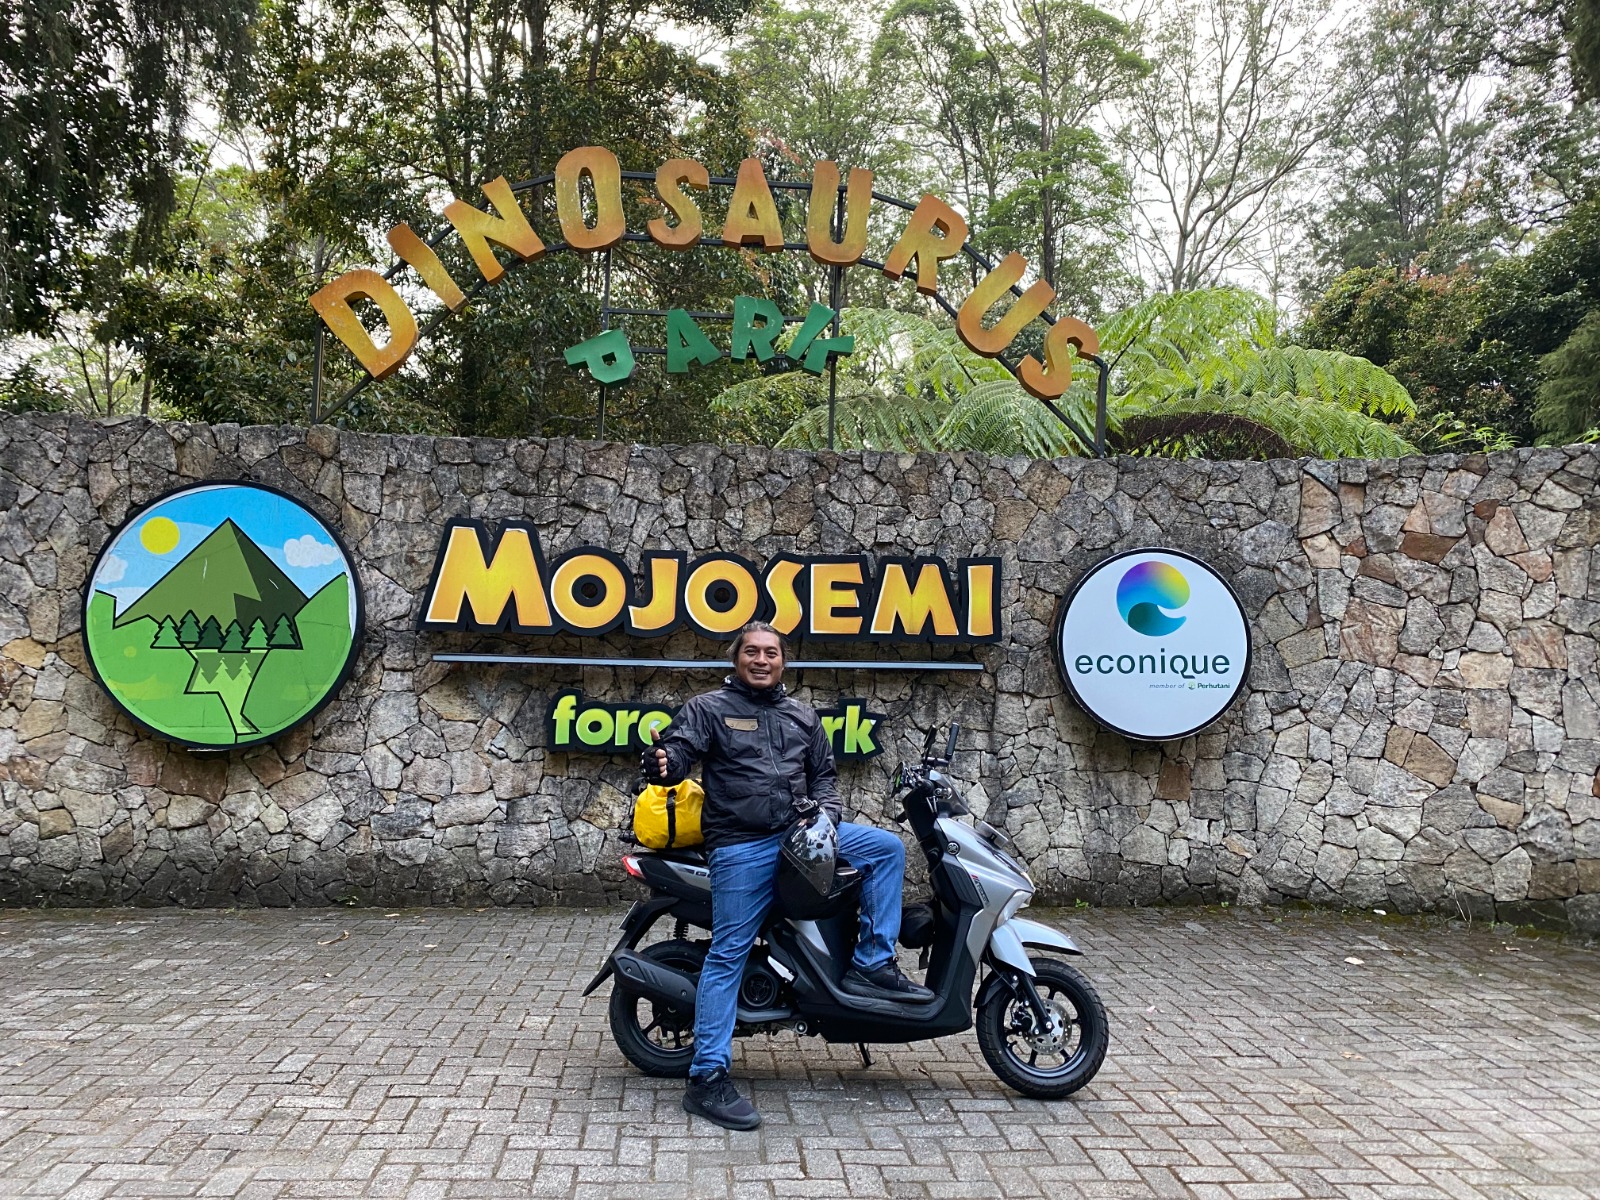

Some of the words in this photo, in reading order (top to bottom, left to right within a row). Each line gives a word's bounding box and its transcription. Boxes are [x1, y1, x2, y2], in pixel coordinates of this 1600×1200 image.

[309, 145, 1100, 400] DINOSAURUS
[564, 294, 854, 387] PARK
[424, 525, 995, 637] MOJOSEMI
[1075, 648, 1230, 679] econique
[552, 694, 673, 747] fore
[821, 704, 877, 755] rk
